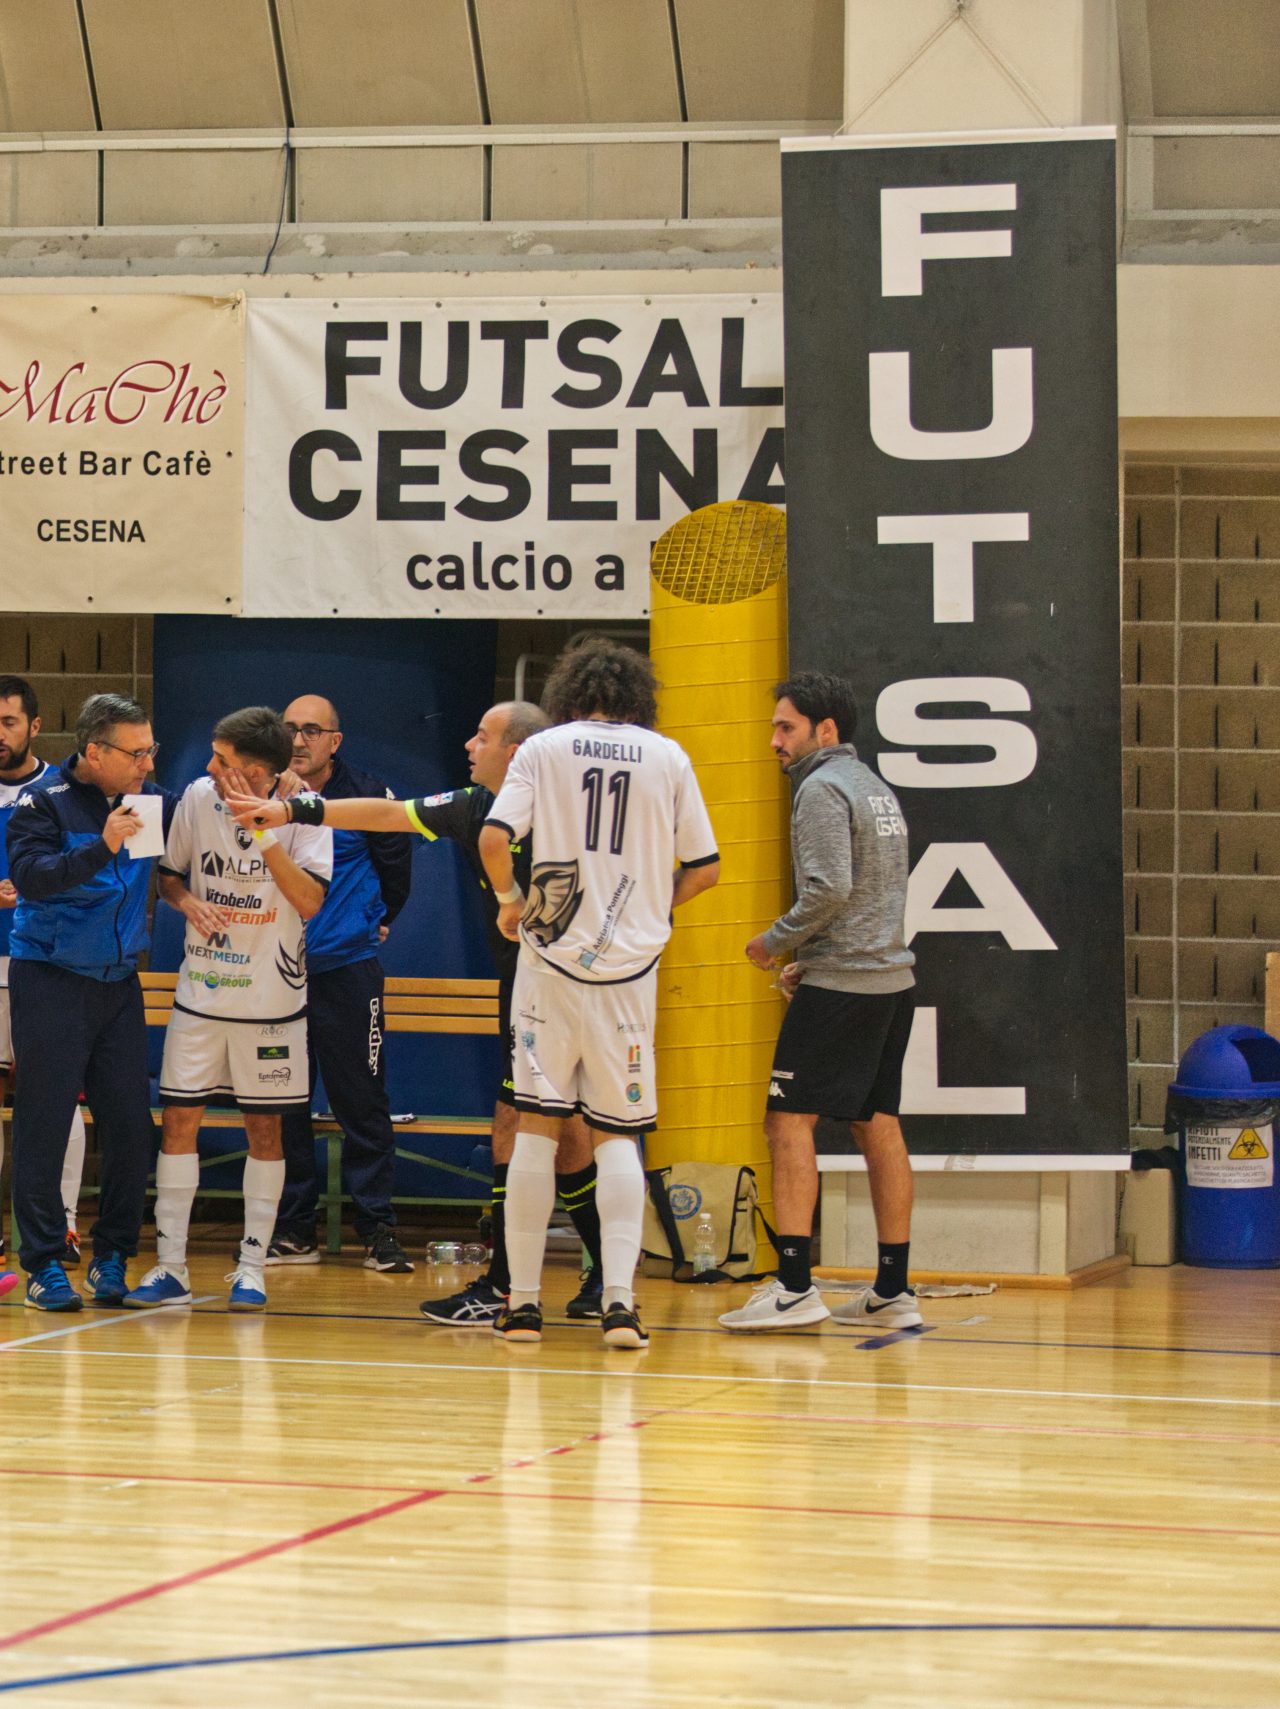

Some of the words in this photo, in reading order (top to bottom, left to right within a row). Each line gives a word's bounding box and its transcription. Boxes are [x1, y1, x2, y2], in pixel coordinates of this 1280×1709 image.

[324, 317, 784, 411] FUTSAL
[79, 451, 133, 476] Bar
[142, 450, 212, 476] Cafè
[36, 519, 146, 543] CESENA
[406, 541, 573, 592] calcio
[594, 553, 625, 592] a
[869, 184, 1059, 1115] FUTSAL
[572, 738, 642, 764] GARDELLI
[581, 767, 631, 856] 11
[186, 943, 251, 965] NEXTMEDIA
[1188, 1145, 1221, 1161] INFETTI
